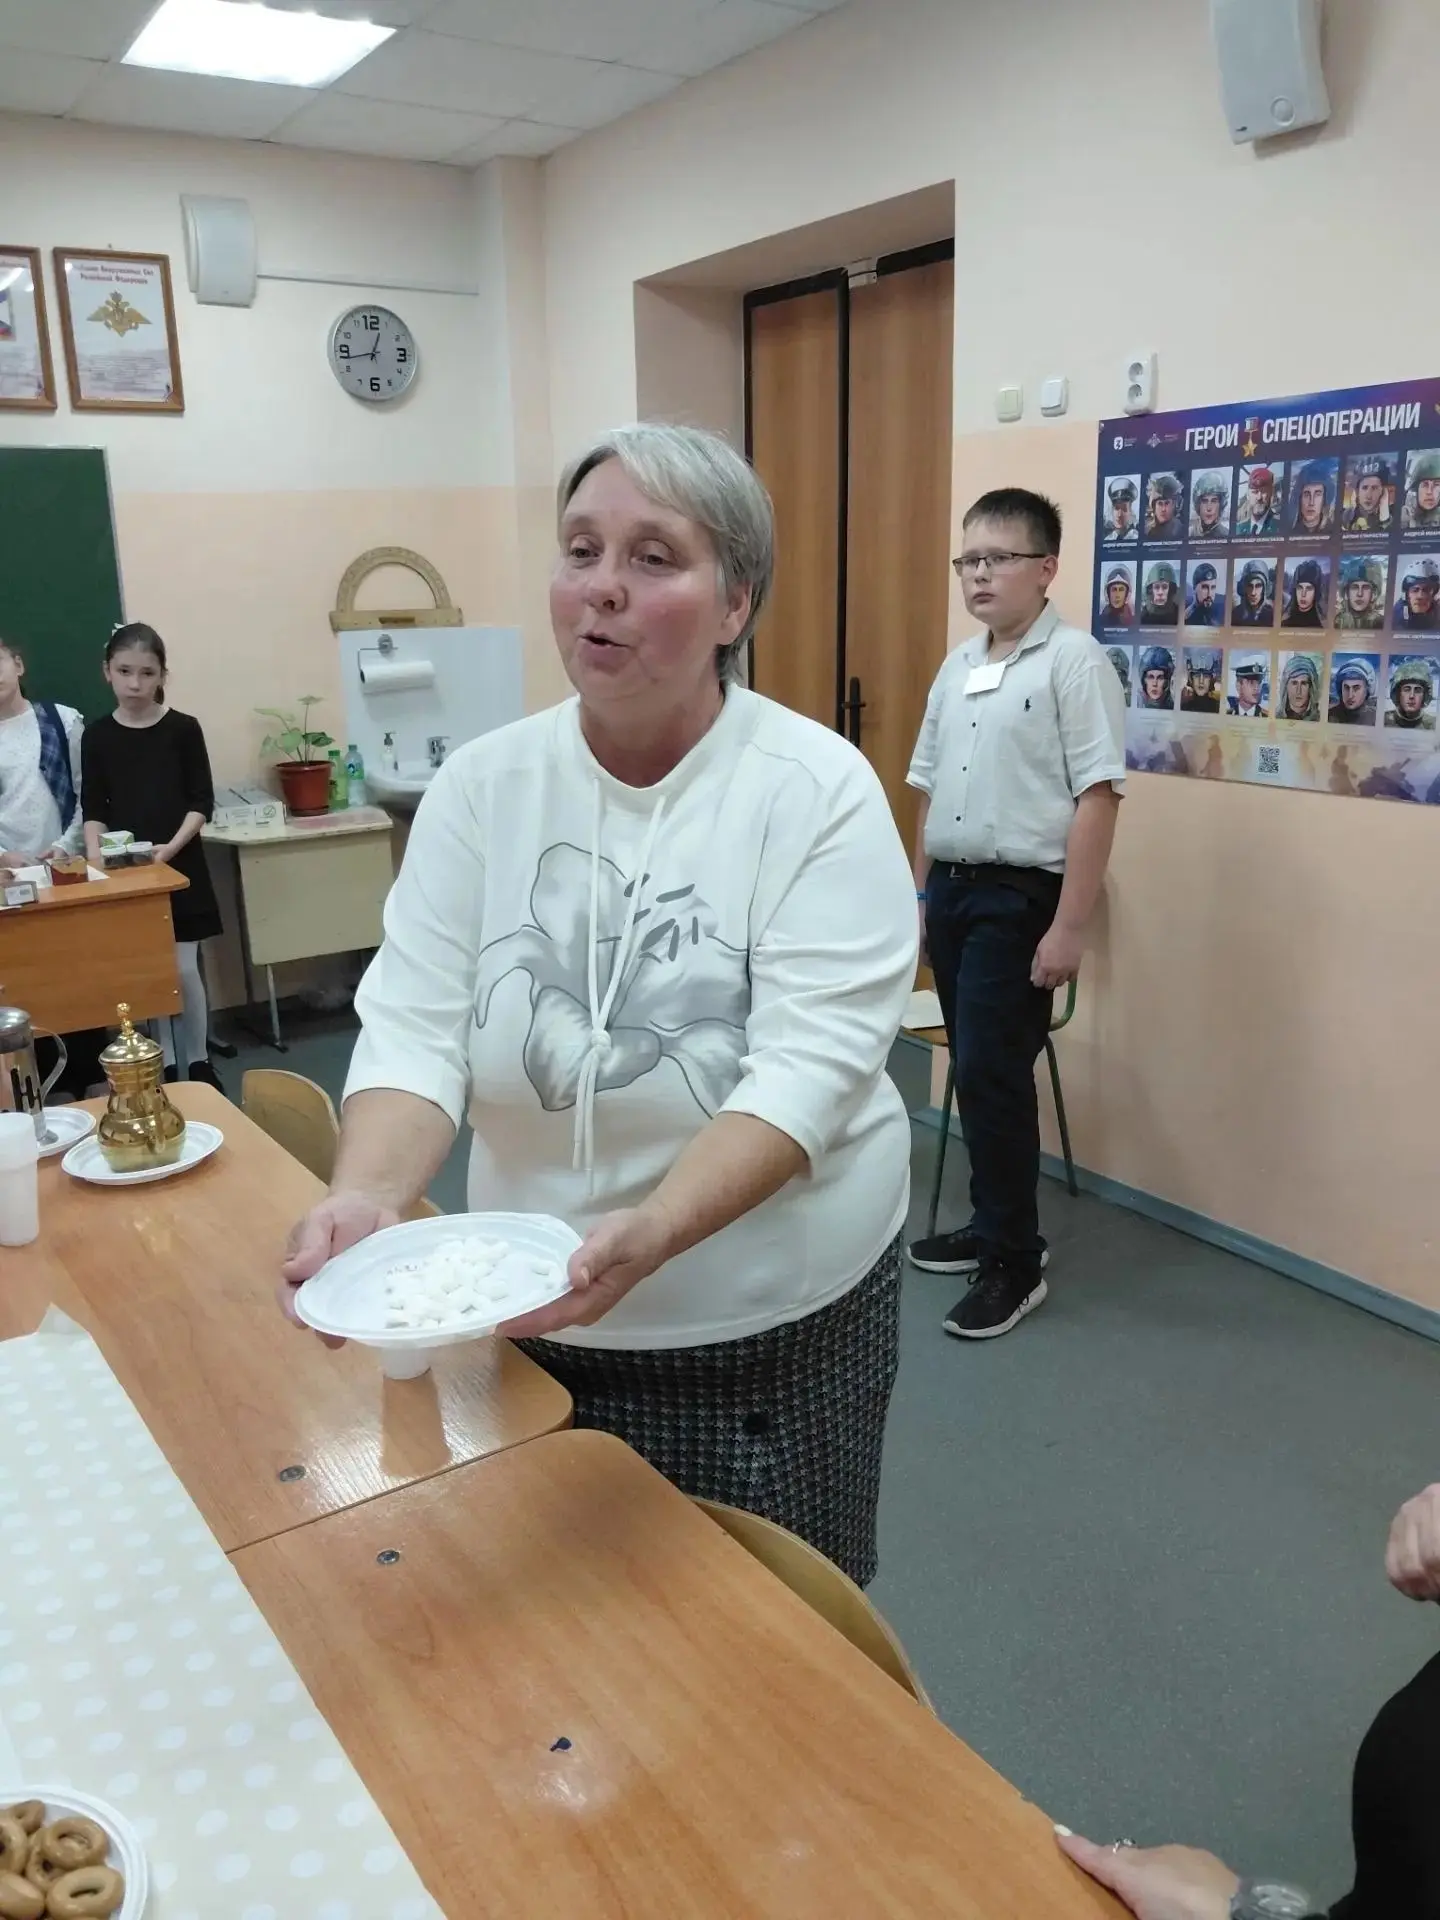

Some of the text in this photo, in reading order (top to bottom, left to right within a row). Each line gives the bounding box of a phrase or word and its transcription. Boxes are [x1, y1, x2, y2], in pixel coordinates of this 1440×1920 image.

[362, 315, 380, 330] 12
[339, 344, 350, 359] 9
[396, 347, 407, 362] 3
[369, 377, 380, 391] 6
[1185, 402, 1422, 451] ГЕРОИ СПЕЦОПЕРАЦИИ
